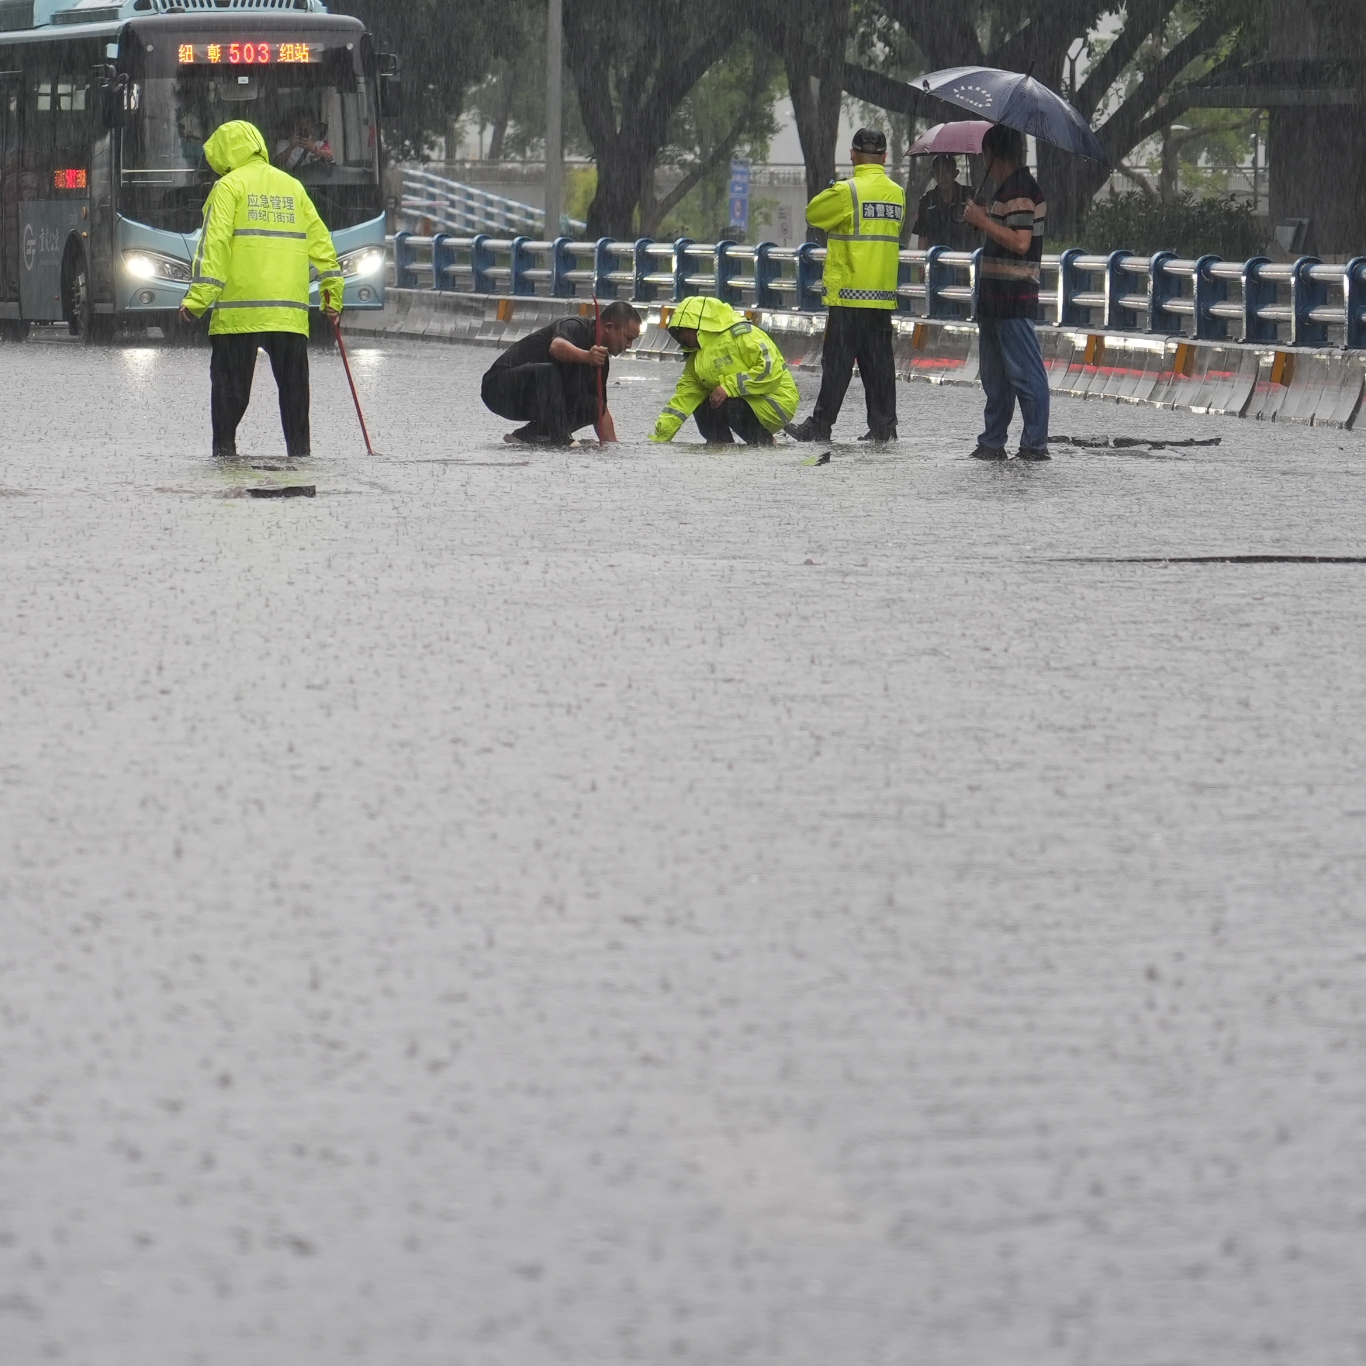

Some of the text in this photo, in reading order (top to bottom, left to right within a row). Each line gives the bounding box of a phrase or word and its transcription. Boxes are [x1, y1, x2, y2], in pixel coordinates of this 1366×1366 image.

[229, 43, 269, 64] 503
[277, 43, 310, 63] 纽站
[247, 194, 295, 211] 应急管理
[247, 209, 296, 224] 南纪门街道
